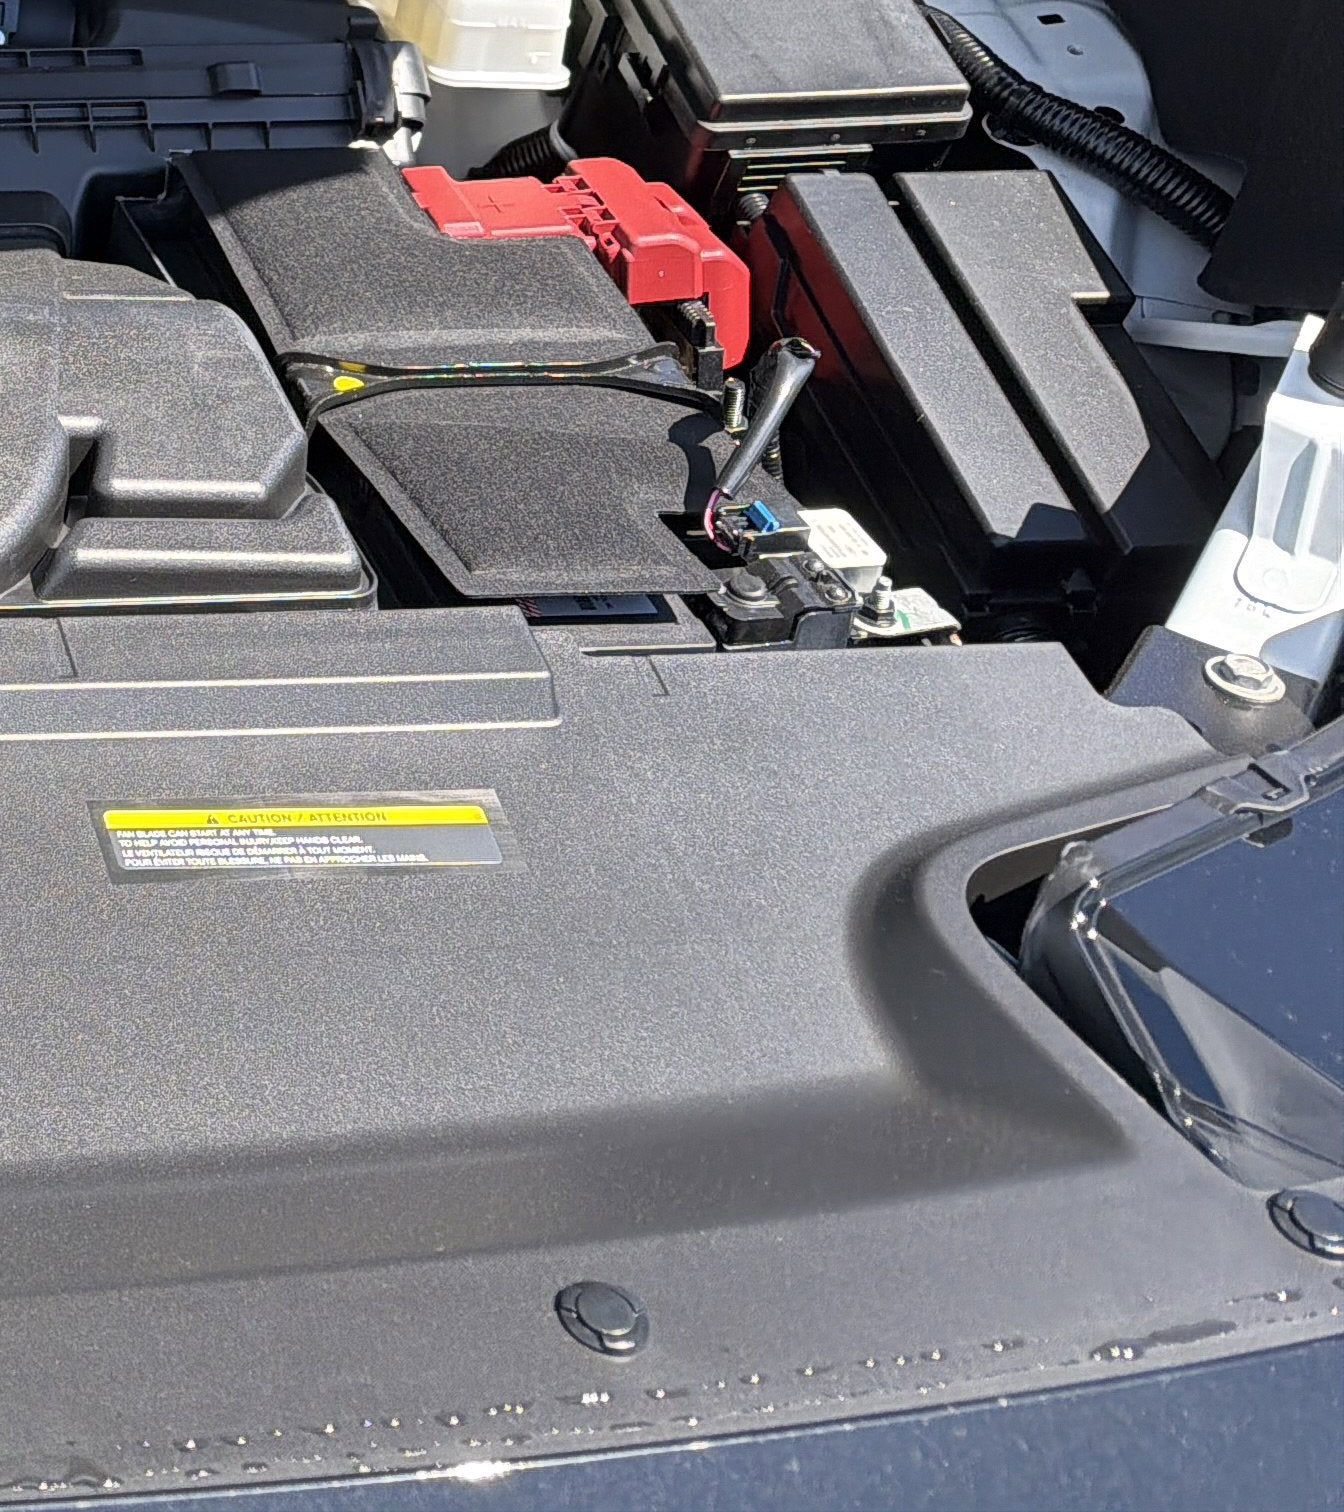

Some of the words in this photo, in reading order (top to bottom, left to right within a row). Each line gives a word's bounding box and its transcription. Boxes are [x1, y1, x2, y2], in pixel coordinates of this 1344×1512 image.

[227, 813, 292, 824] CAUTION
[309, 811, 387, 823] ATTENTION
[116, 830, 135, 838] FAN
[167, 830, 188, 838] CAN
